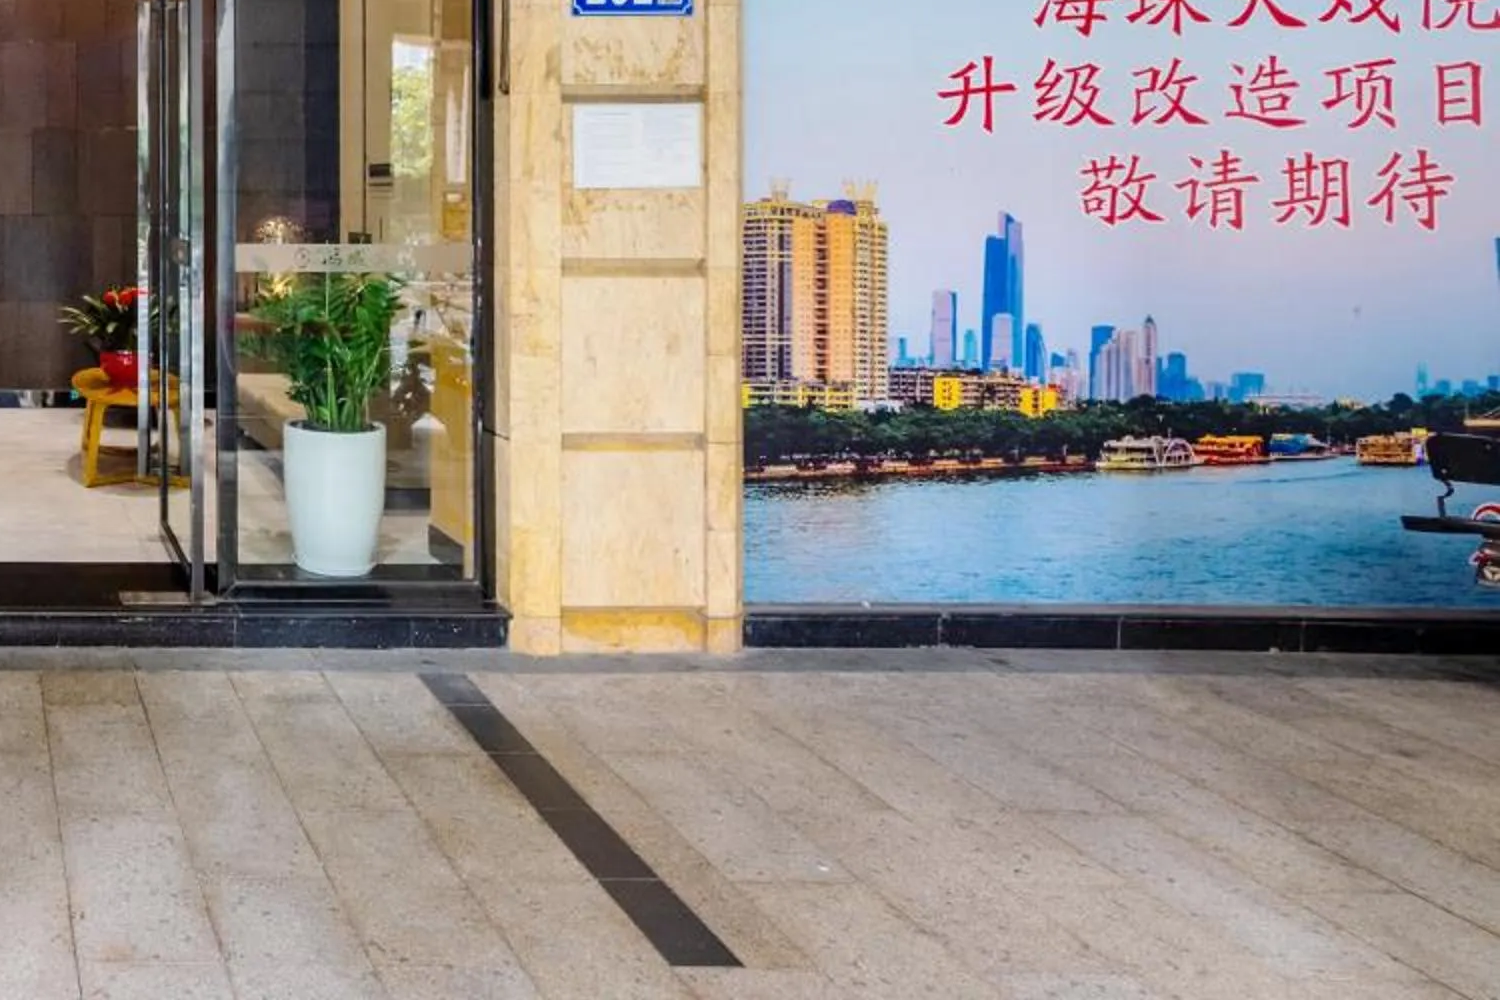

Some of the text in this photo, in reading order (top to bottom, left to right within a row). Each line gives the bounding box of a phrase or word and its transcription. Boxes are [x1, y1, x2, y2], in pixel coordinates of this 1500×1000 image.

[937, 54, 1484, 134] 升级改造项目
[1078, 150, 1455, 231] 敬请期待
